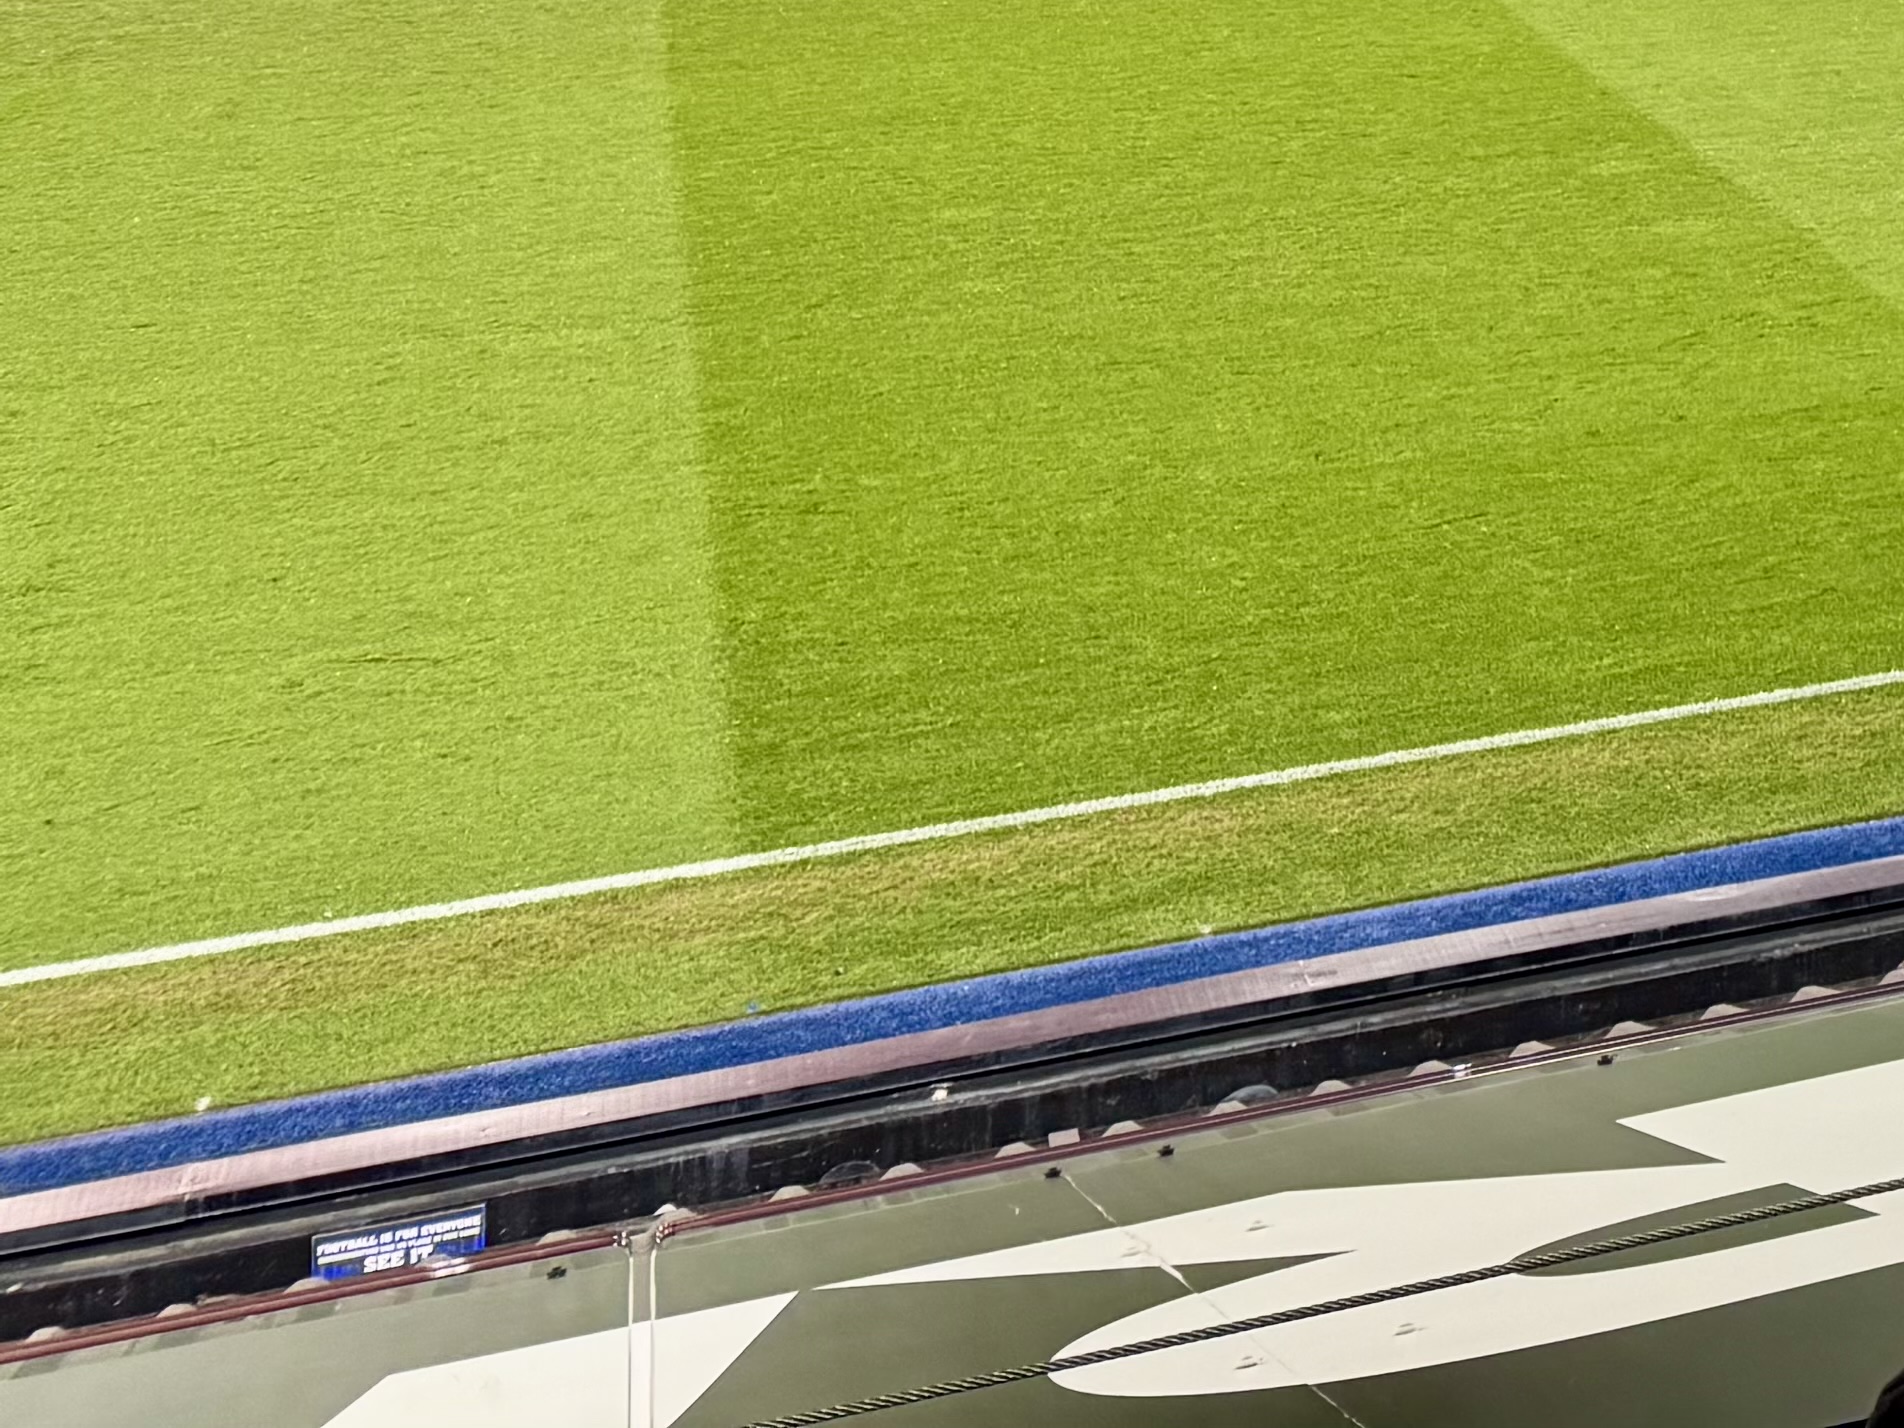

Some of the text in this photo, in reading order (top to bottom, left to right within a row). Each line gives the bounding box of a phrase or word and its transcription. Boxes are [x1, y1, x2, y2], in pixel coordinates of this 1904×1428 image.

[317, 1235, 379, 1257] FOOTBALL
[379, 1231, 394, 1245] IS
[395, 1227, 419, 1242] FOR
[420, 1214, 482, 1237] EVERYONE
[364, 1250, 406, 1274] SEE
[409, 1244, 434, 1265] IT
